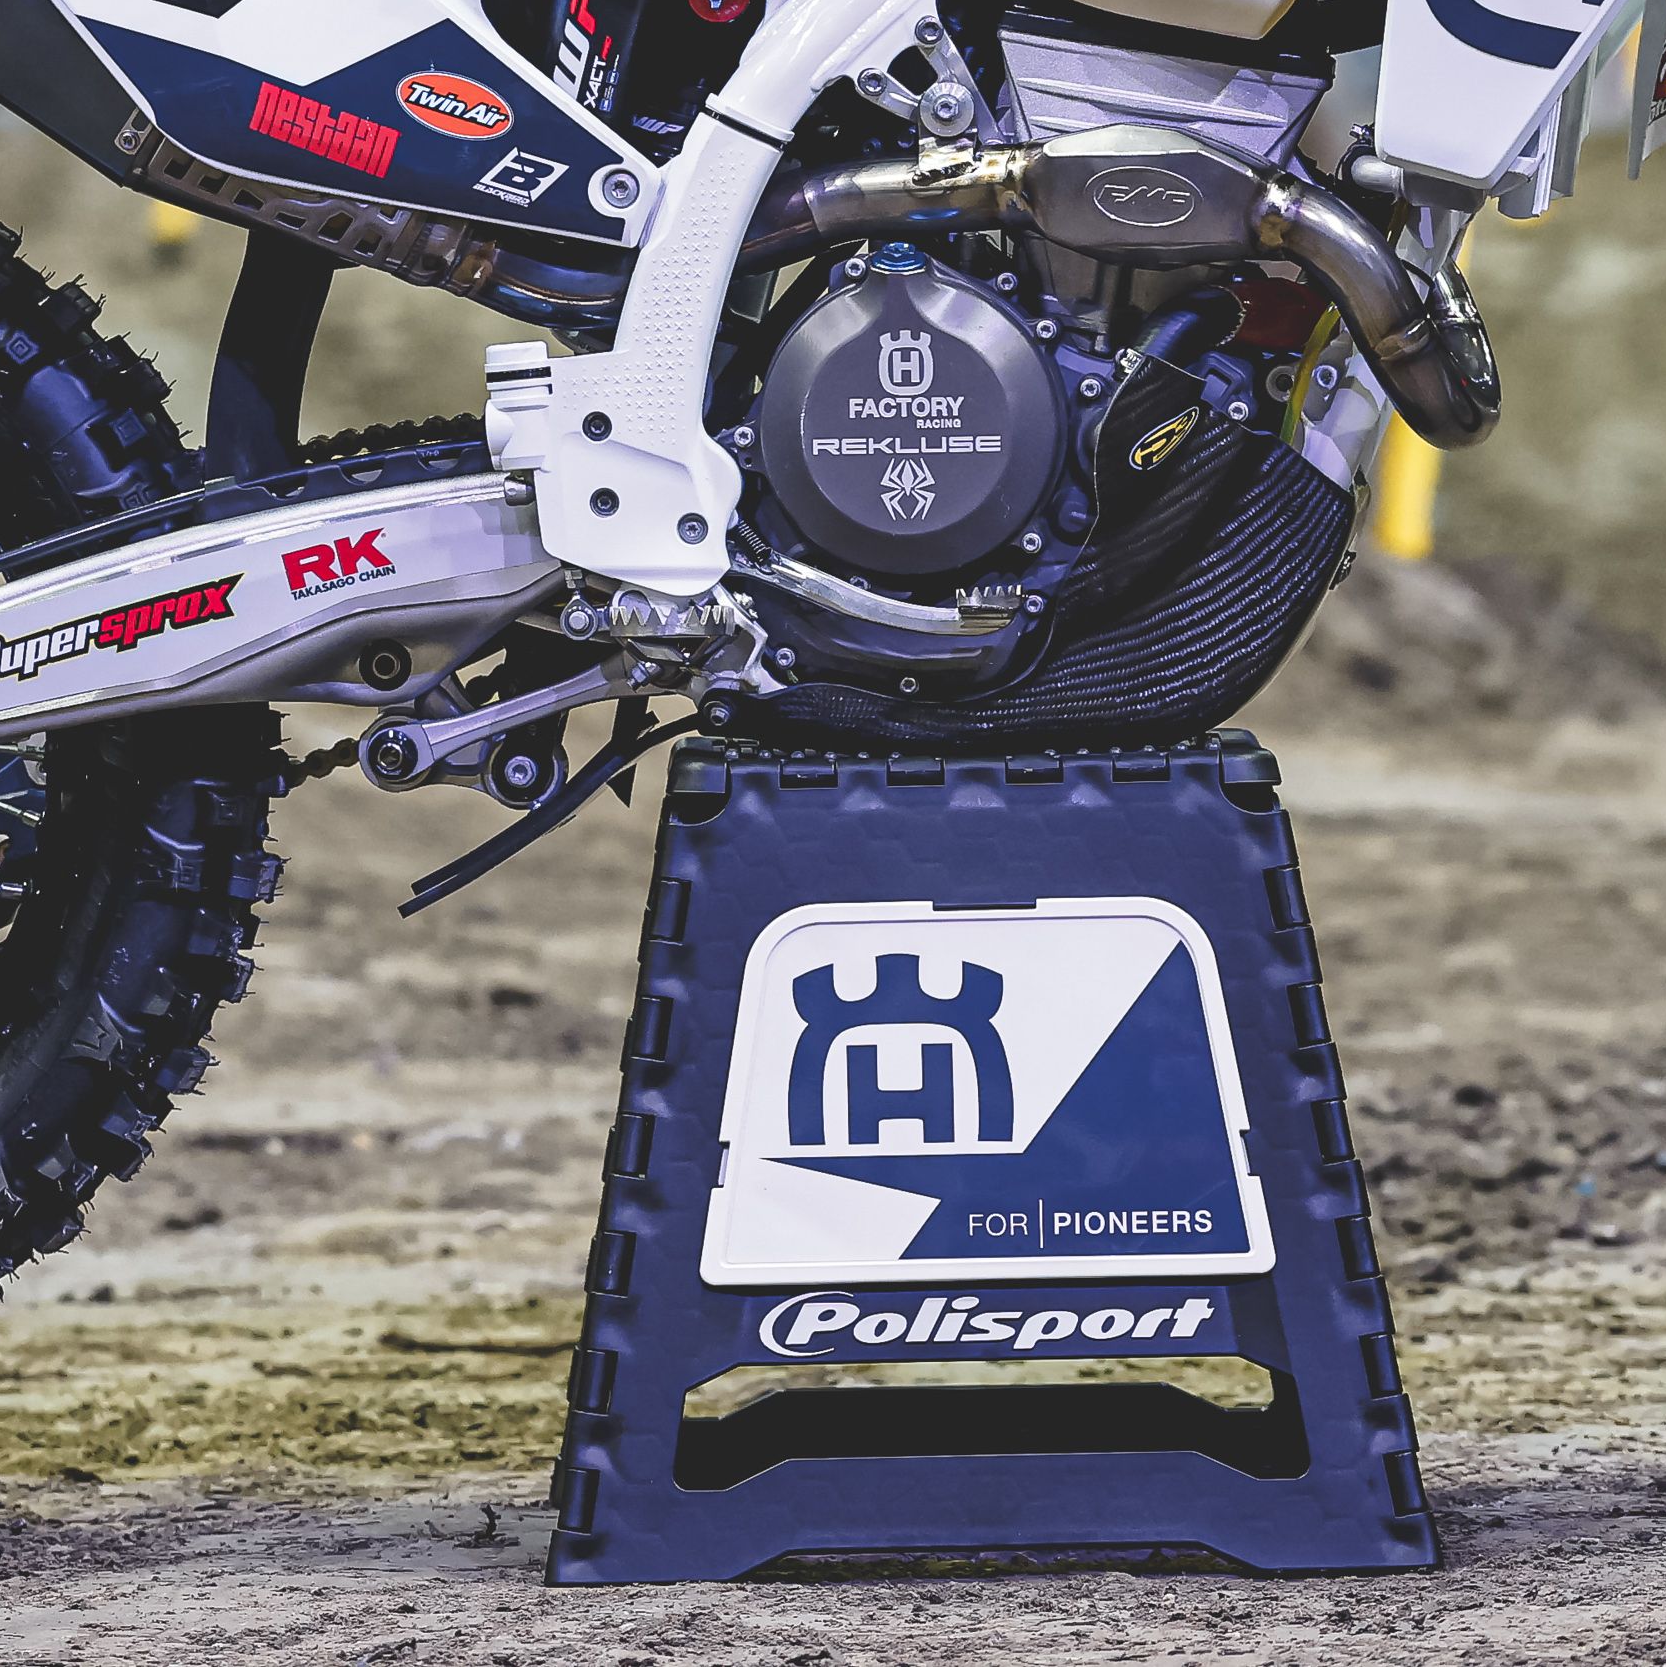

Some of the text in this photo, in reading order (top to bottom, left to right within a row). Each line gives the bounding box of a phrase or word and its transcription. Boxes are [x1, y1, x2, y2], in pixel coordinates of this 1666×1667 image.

[583, 54, 607, 109] XACT
[409, 83, 508, 128] Twin Air
[848, 395, 965, 419] FACTORY
[916, 417, 962, 429] RACING
[812, 435, 1002, 455] REKLUSE
[281, 527, 394, 591] RK
[291, 565, 396, 601] TAKASAGO CHAIN
[968, 1209, 1214, 1237] FOR PIONEERS
[780, 1293, 1216, 1353] Polisport
